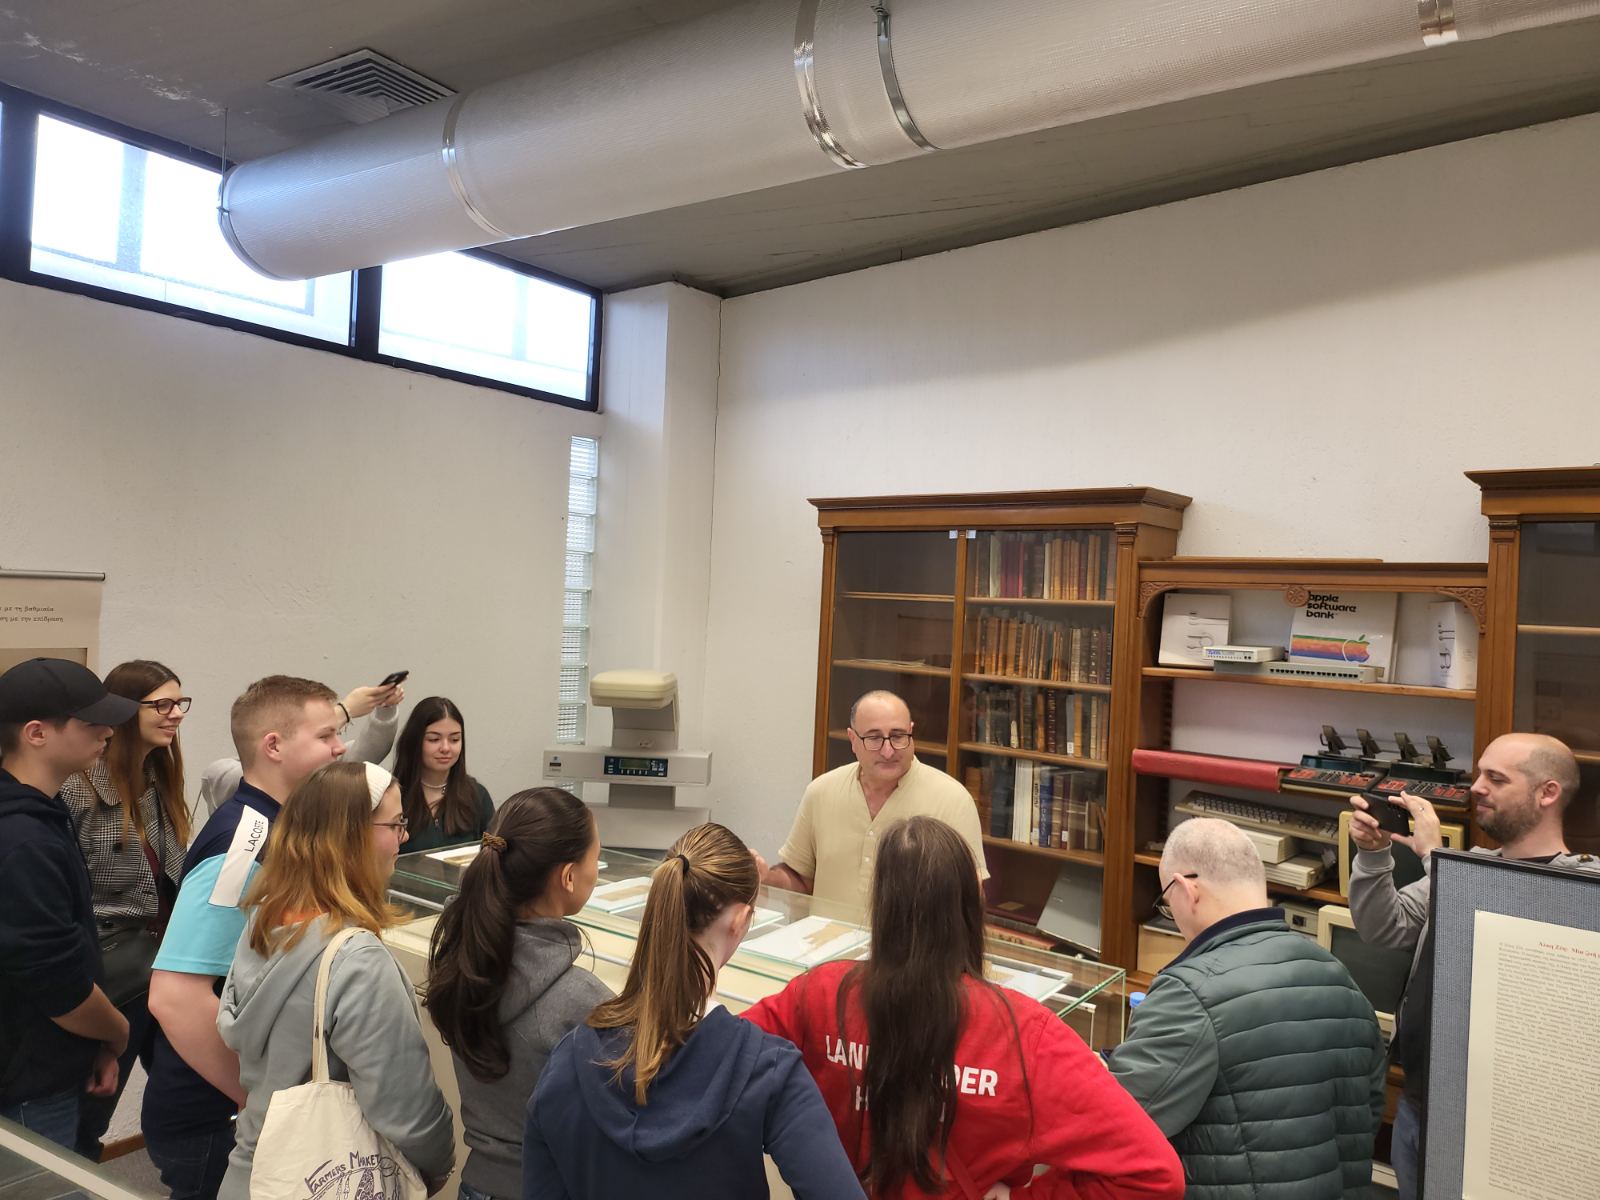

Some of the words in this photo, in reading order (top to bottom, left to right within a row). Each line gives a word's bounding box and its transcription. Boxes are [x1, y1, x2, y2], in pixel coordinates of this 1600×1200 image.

[1308, 593, 1339, 602] apple
[1307, 602, 1357, 613] software
[1306, 609, 1335, 619] bank
[304, 1159, 347, 1195] FARMERS
[349, 1150, 381, 1170] MARKET
